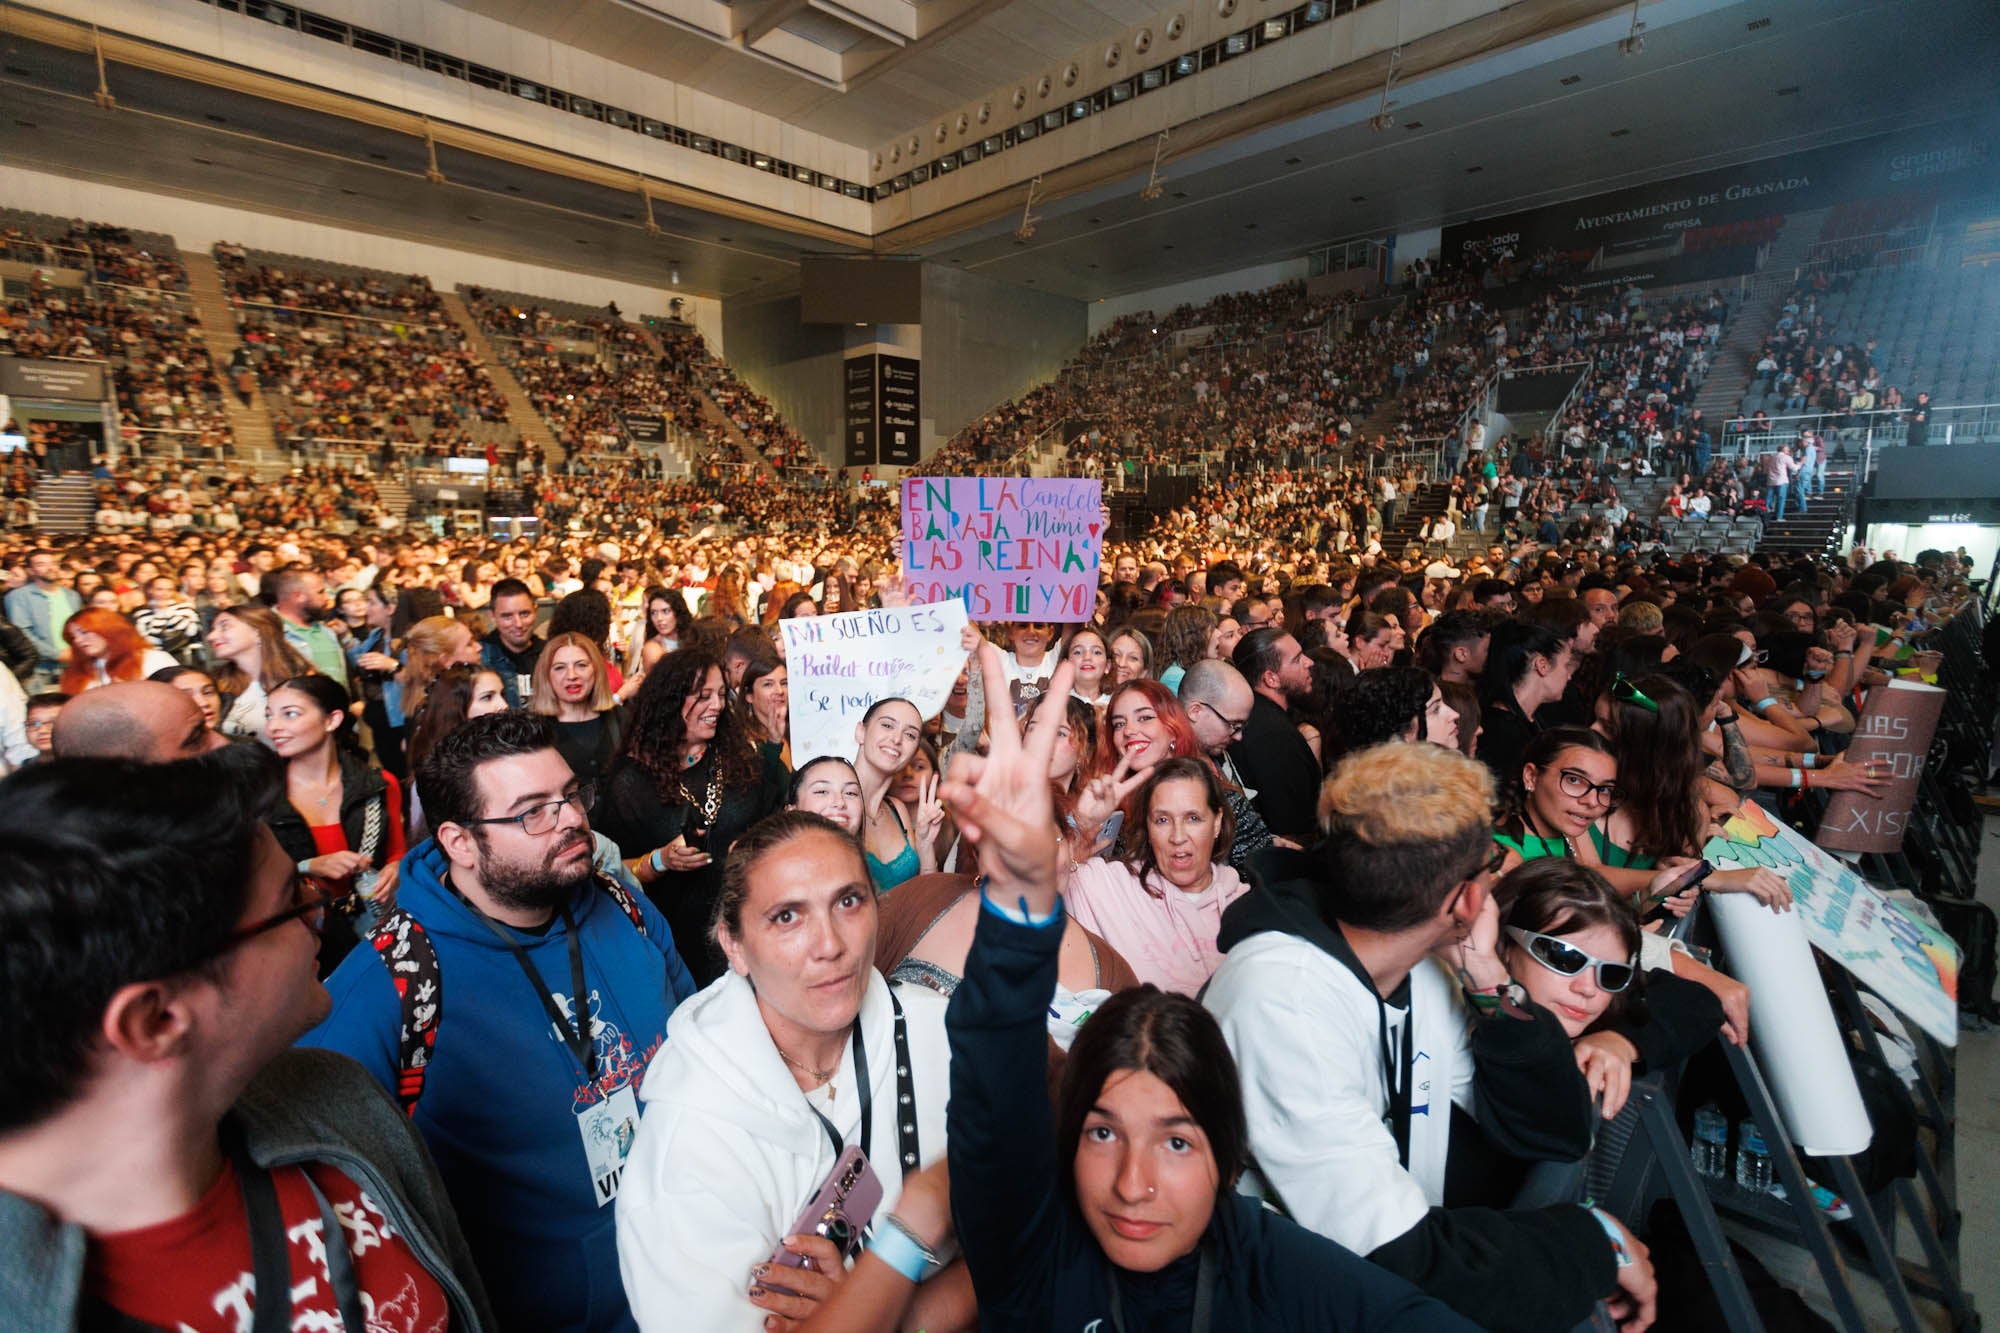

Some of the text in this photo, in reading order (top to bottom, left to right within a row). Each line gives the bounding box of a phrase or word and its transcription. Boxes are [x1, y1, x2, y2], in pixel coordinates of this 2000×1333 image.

[908, 478, 1019, 511] EN LA
[912, 511, 1010, 541] BARAJA
[1021, 509, 1085, 538] Mimi
[909, 538, 1099, 574] LAS REINAS
[908, 581, 991, 615] SOMOS
[1002, 576, 1031, 614] TÚ
[787, 609, 944, 647] MI SUEÑO ES
[809, 689, 832, 713] Se
[598, 1164, 625, 1199] VI
